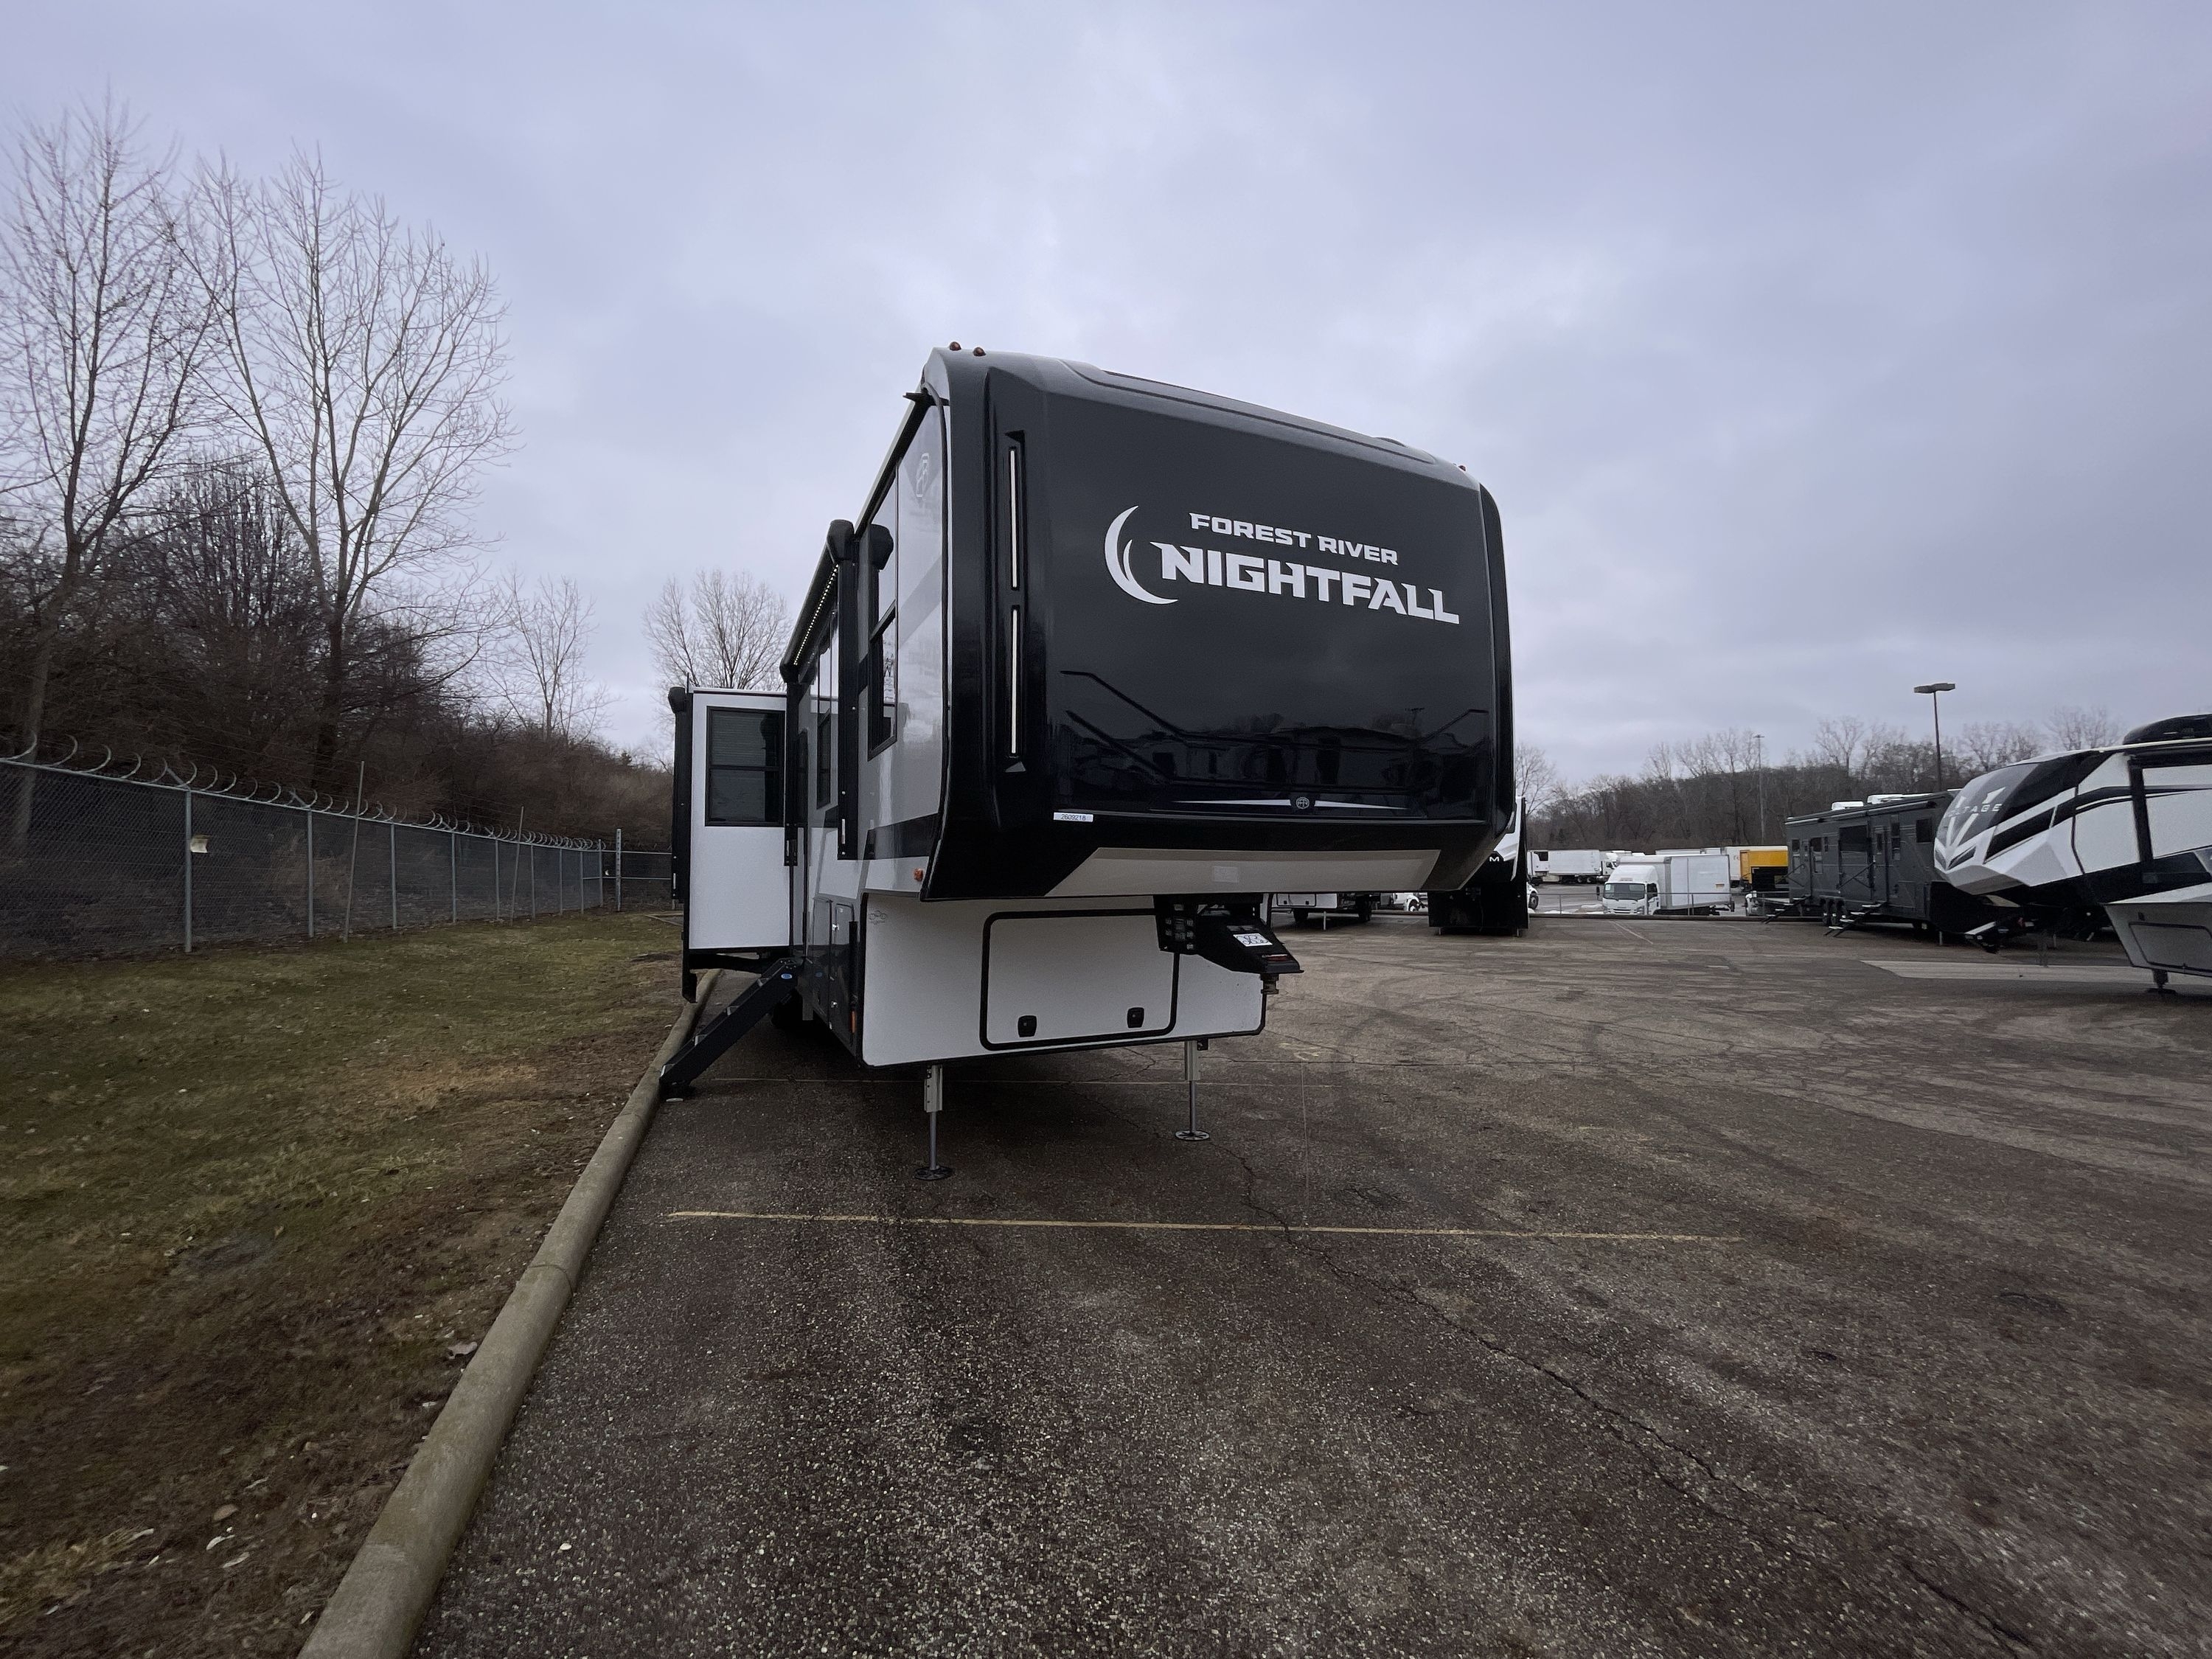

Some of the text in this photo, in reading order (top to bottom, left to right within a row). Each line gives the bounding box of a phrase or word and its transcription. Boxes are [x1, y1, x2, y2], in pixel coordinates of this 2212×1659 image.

[1189, 512, 1399, 566] FOREST RIVER
[1150, 541, 1461, 625] NIGHTFALL
